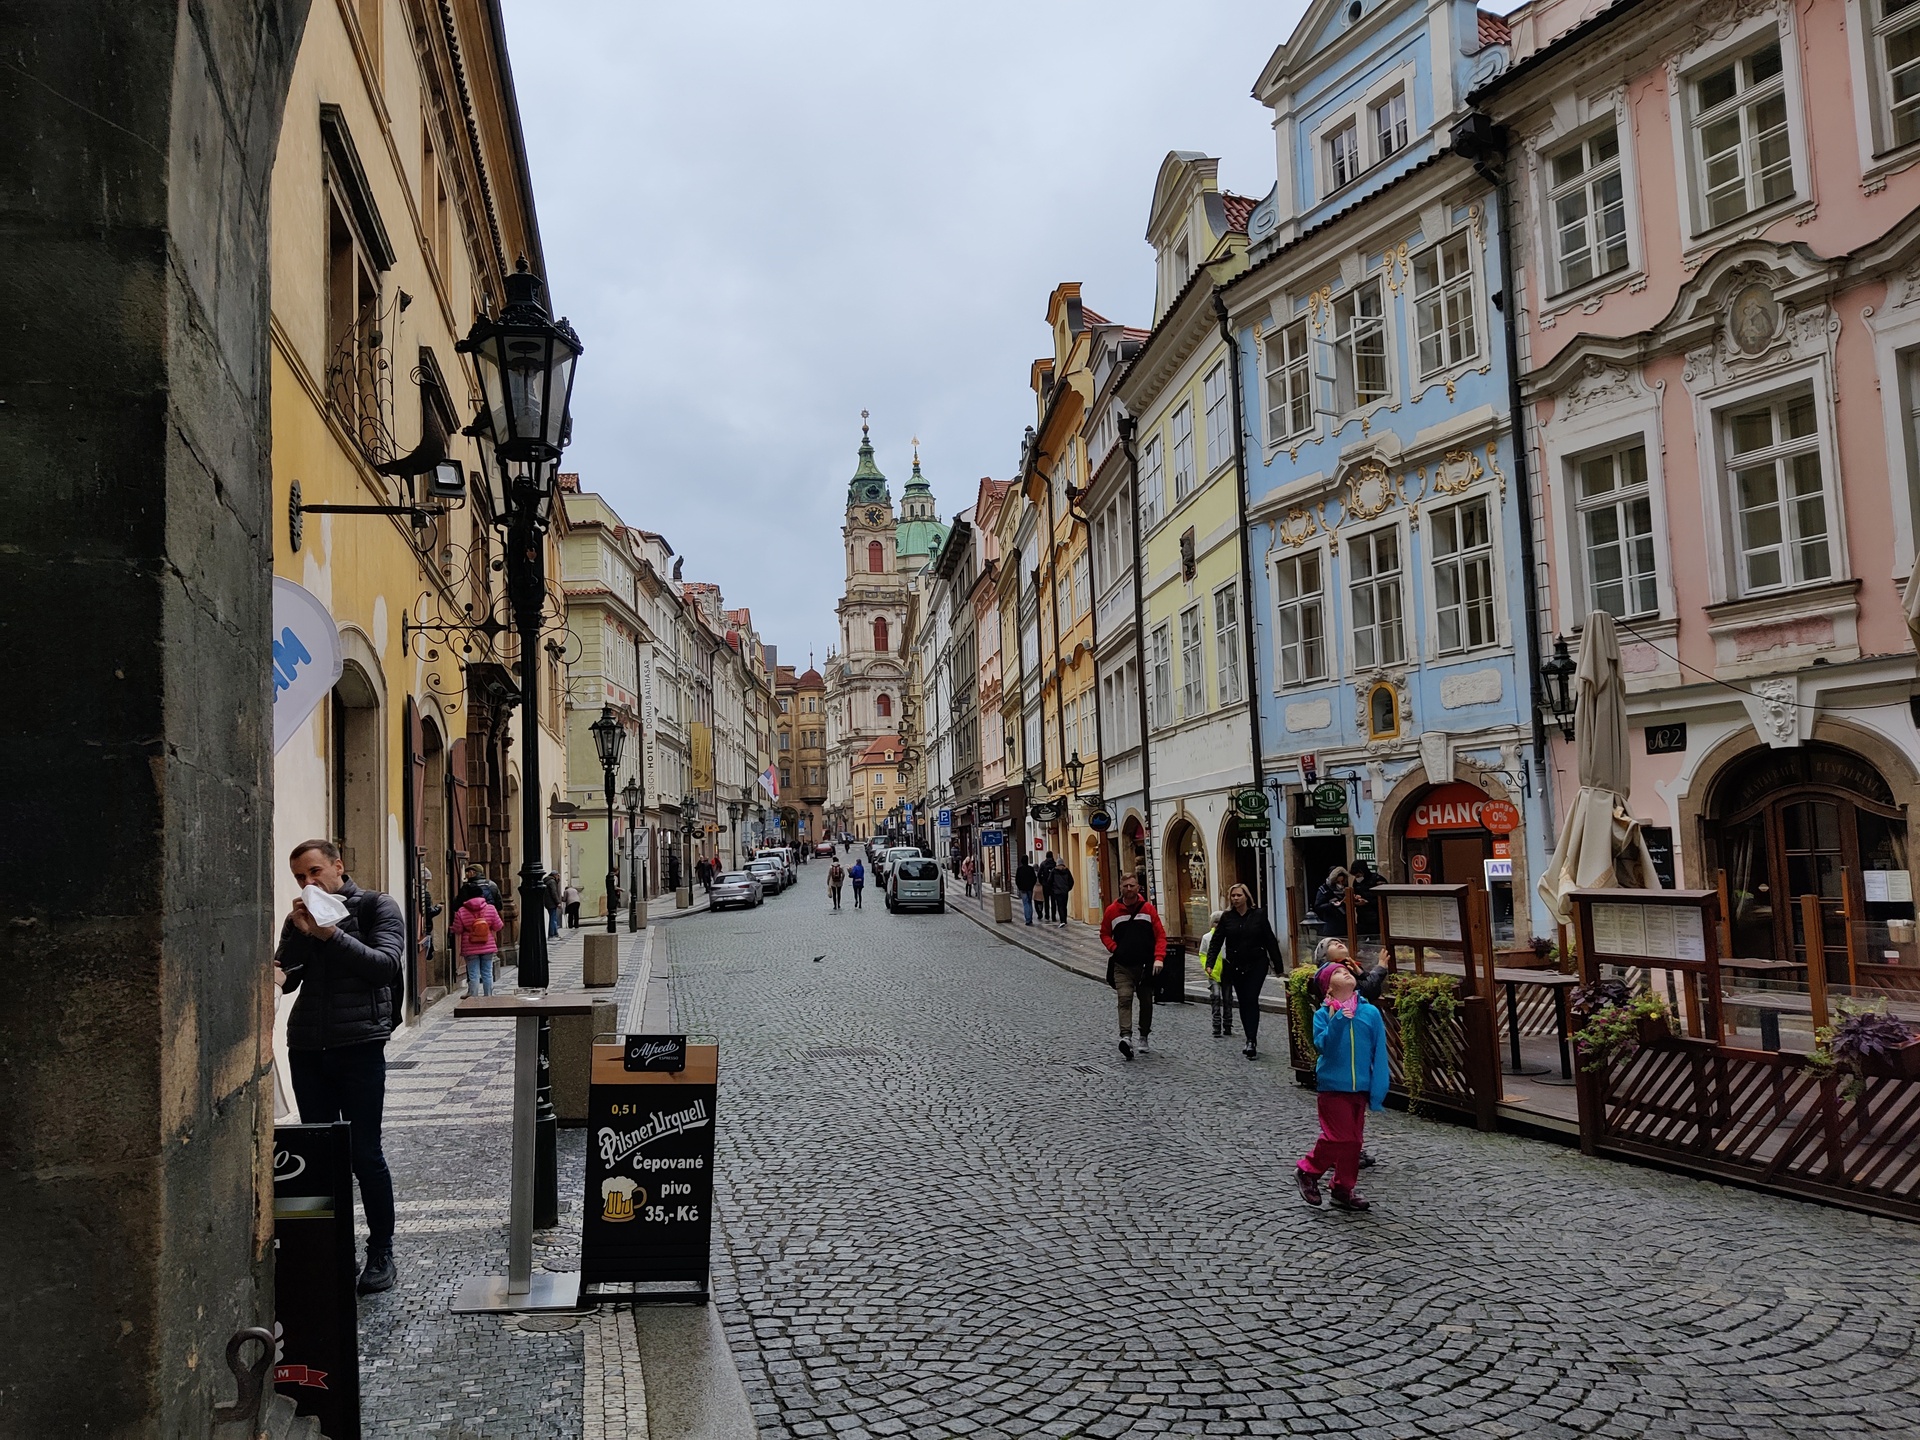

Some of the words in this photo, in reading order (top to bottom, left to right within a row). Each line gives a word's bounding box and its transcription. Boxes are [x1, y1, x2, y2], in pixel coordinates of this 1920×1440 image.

[644, 659, 652, 700] BALTHASAR
[1671, 728, 1682, 747] 2
[941, 811, 948, 821] P
[1485, 801, 1514, 813] change
[1492, 811, 1508, 822] 0%
[1249, 838, 1269, 848] WC
[631, 1040, 680, 1061] Alfredo
[611, 1104, 629, 1116] 0,5
[597, 1121, 655, 1170] Pilsner
[649, 1099, 707, 1135] Urquell
[632, 1152, 704, 1173] Čepované
[661, 1180, 692, 1198] pivo
[644, 1205, 675, 1225] 35,-
[676, 1205, 699, 1221] Kč
